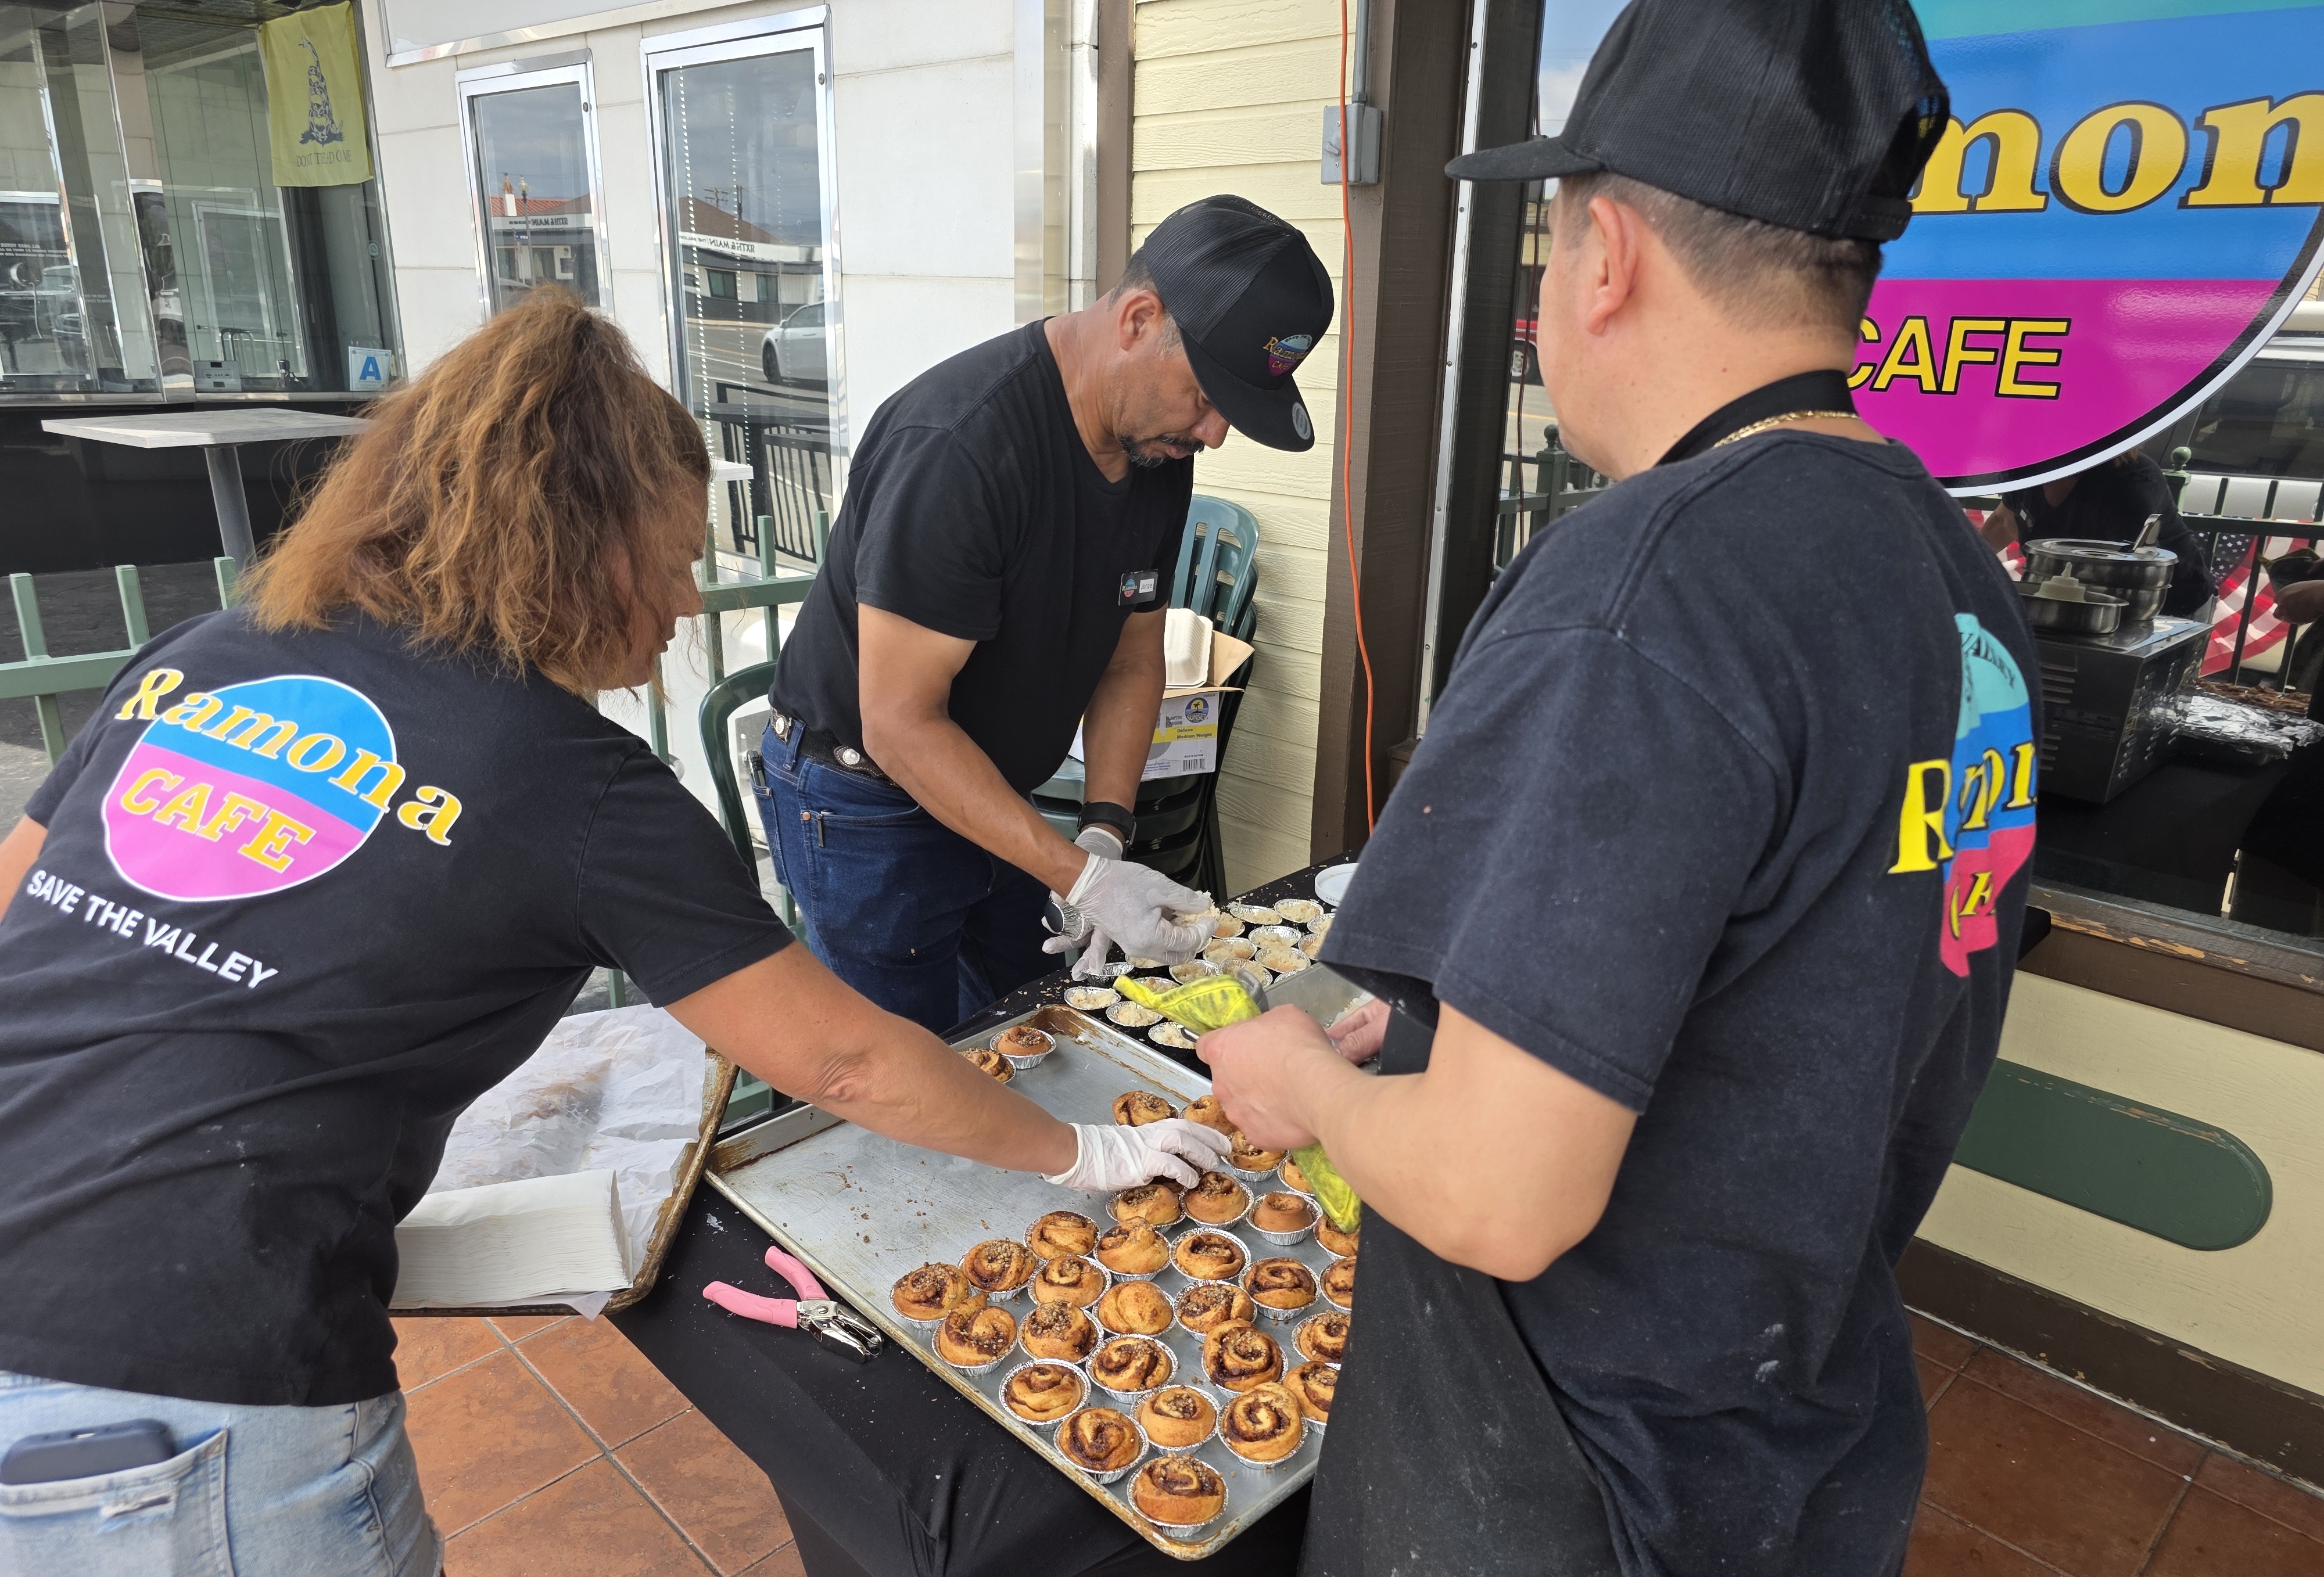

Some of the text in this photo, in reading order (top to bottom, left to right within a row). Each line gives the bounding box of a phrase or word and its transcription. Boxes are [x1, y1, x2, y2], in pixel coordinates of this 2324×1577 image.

[314, 152, 335, 164] TEAD
[359, 355, 382, 380] A
[1272, 361, 1291, 370] CAFE
[1848, 315, 2072, 400] CAFE
[1186, 713, 1207, 721] SUNSET
[114, 668, 462, 846] Ramona
[120, 768, 317, 874] CAFE
[27, 870, 279, 990] SAVE THE VALLEY
